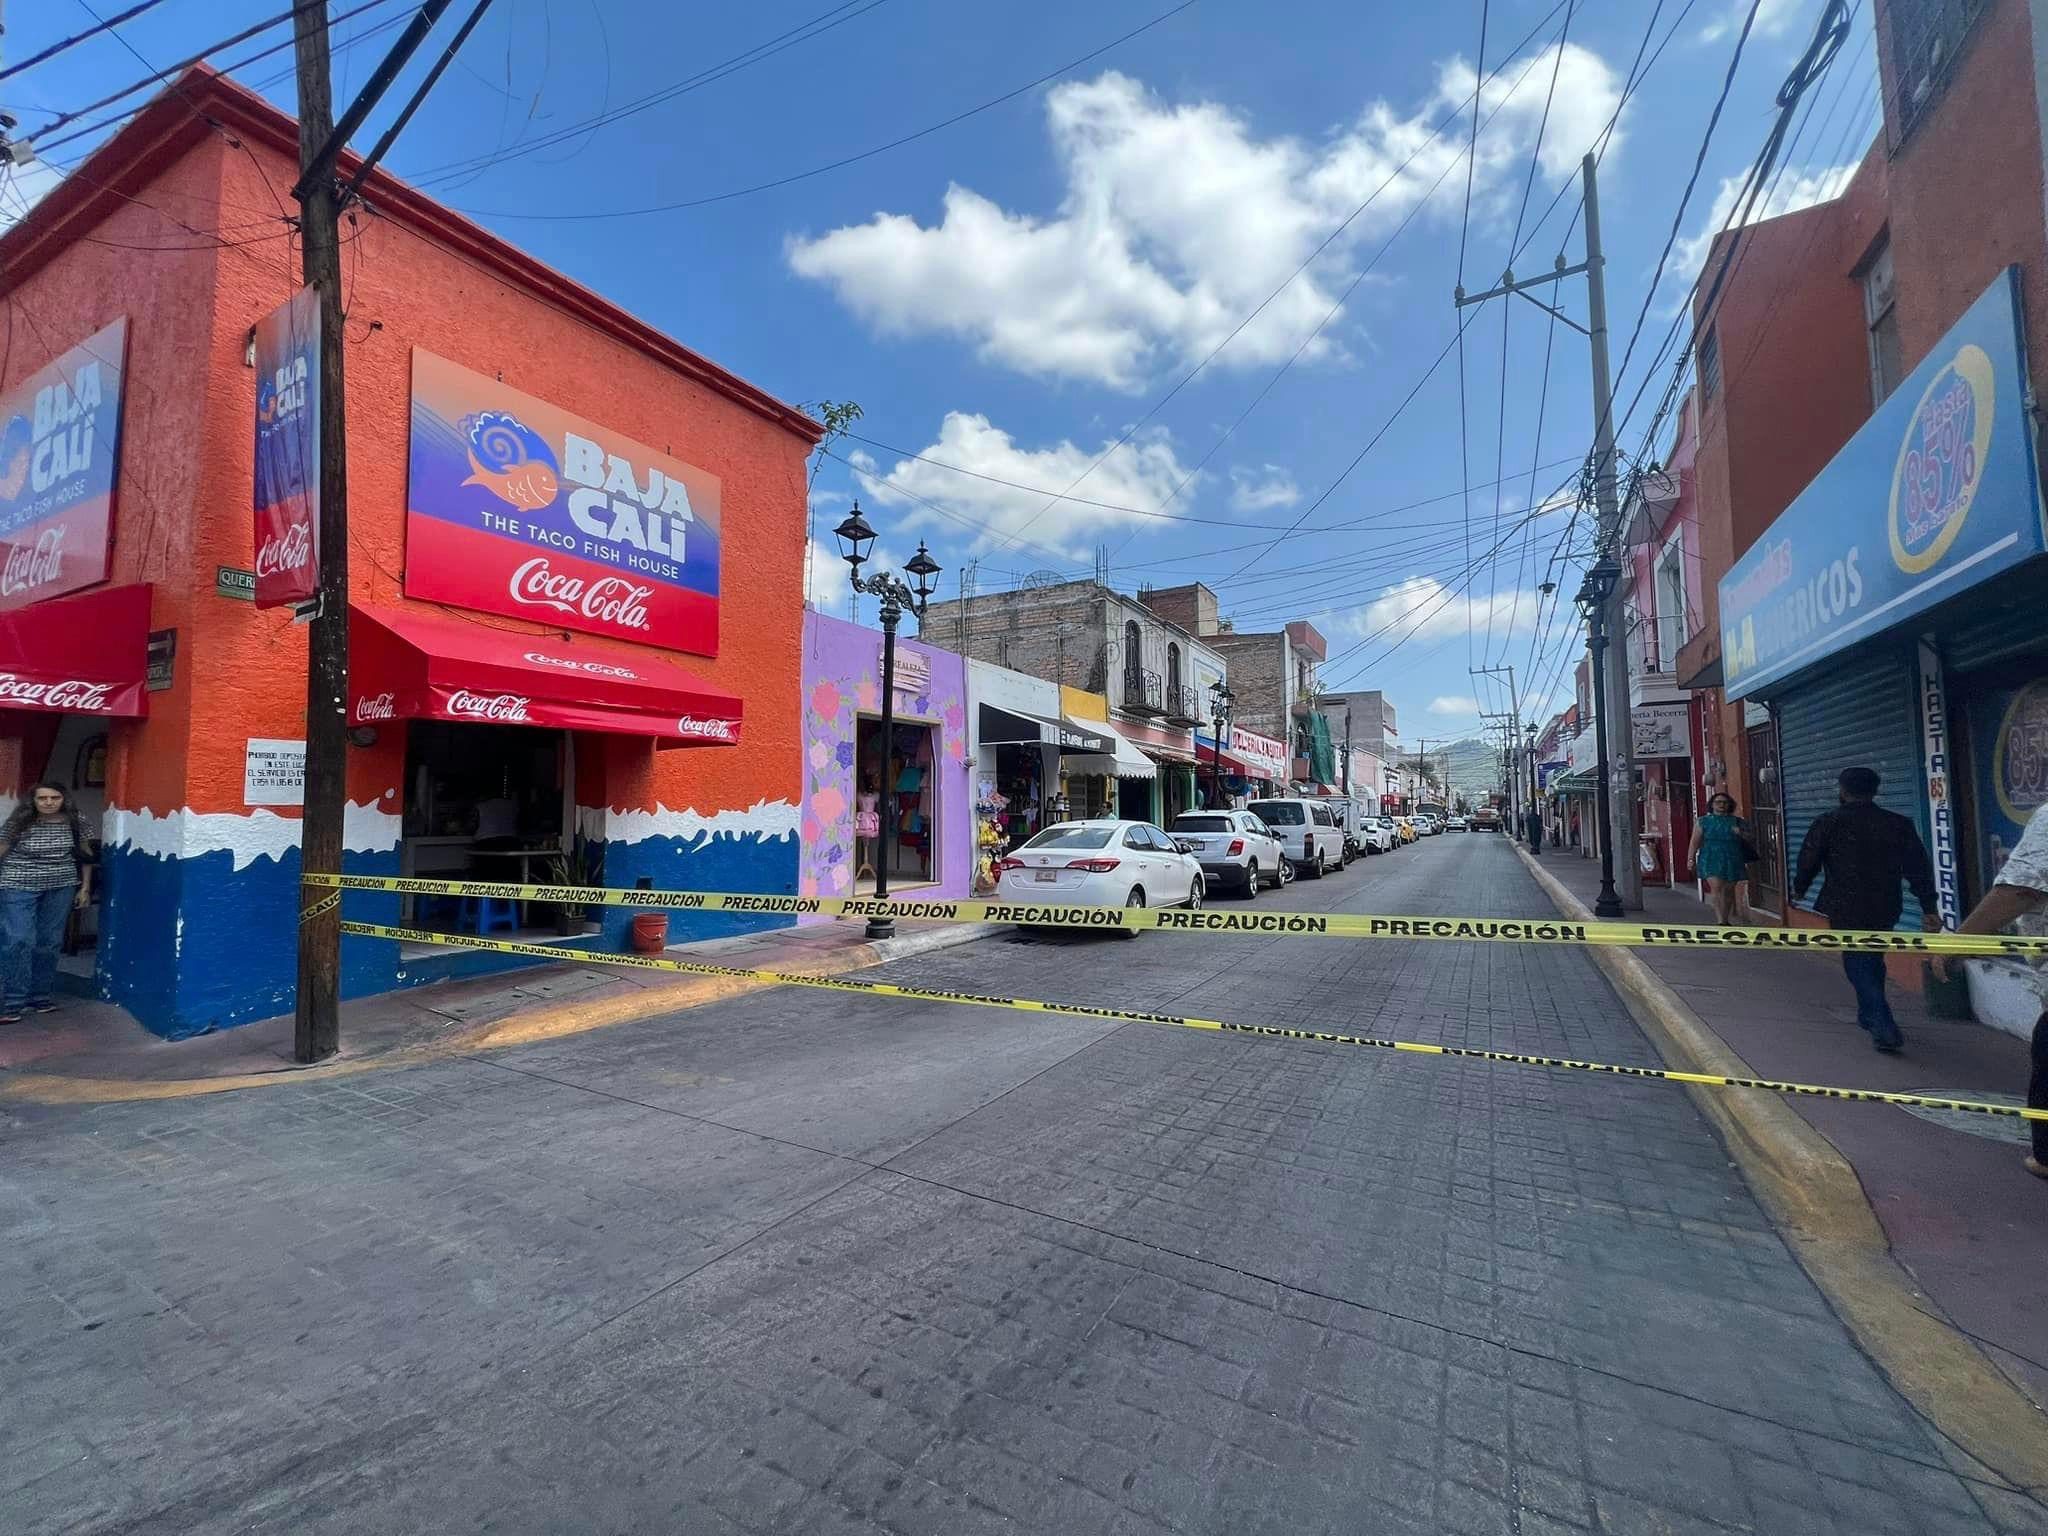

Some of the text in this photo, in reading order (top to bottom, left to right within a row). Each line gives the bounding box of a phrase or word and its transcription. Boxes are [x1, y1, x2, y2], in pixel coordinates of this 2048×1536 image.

[563, 432, 694, 522] BAJA
[481, 511, 680, 579] THE TACO FISH HOUSE
[1653, 710, 1688, 719] Becerra
[841, 900, 957, 919] PRECAUCIÓN
[983, 906, 1123, 926] PRECAUCIÓN
[1156, 912, 1327, 933] PRECAUCIÓN
[1370, 919, 1586, 941] PRECAUCIÓN
[1641, 928, 1928, 951] PRECAUCIÓN
